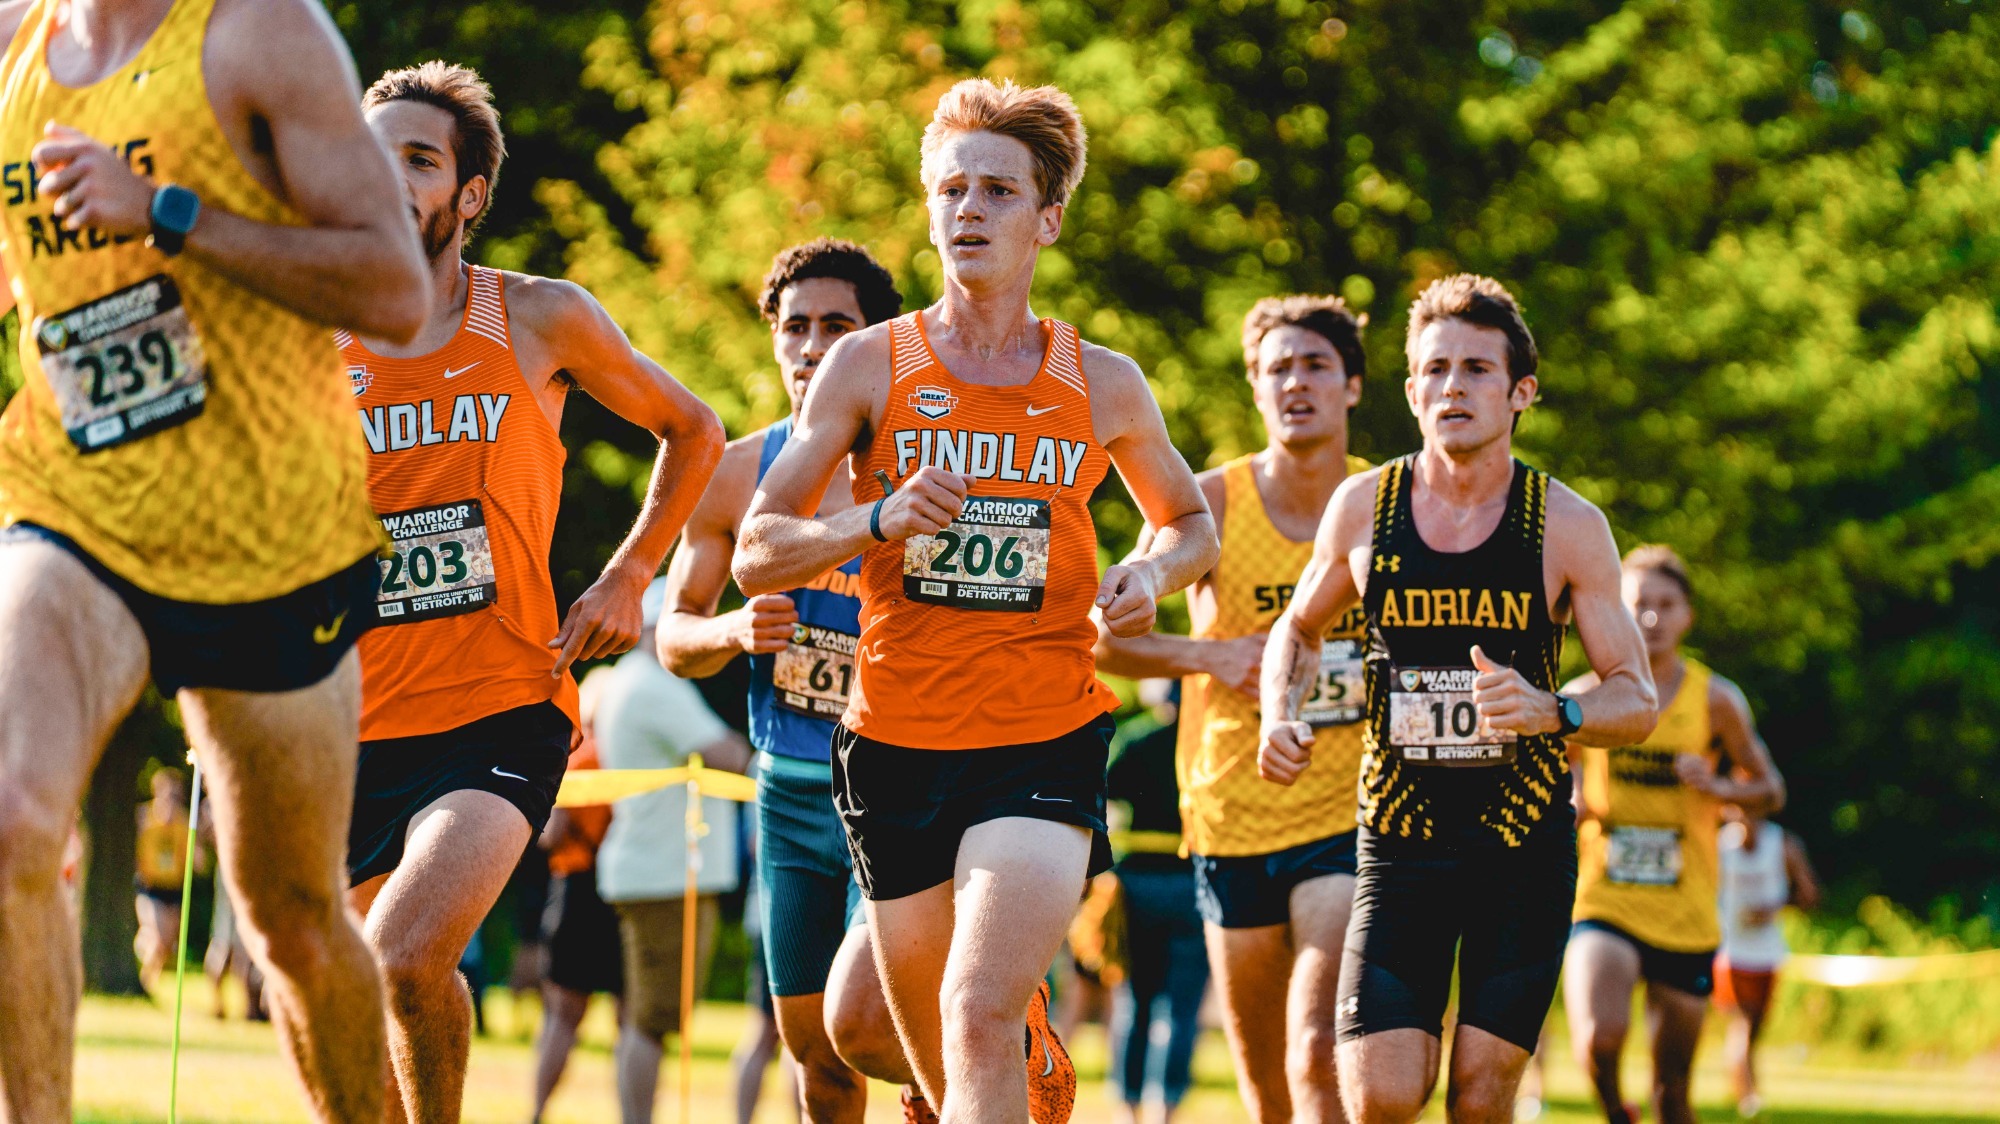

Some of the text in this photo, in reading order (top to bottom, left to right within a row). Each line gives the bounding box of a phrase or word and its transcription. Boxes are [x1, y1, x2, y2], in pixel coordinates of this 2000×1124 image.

[75, 330, 174, 408] 239
[909, 395, 958, 408] MIDWEST
[920, 393, 946, 401] GREAT
[358, 393, 511, 454] NDLAY
[894, 428, 1088, 487] FINDLAY
[382, 505, 469, 531] WARRIOR
[957, 512, 1031, 526] CHALLENGE
[392, 519, 464, 539] CHALLENGE
[930, 530, 1024, 579] 206
[379, 541, 467, 594] 203
[411, 587, 483, 603] WAYNE STATE UNIVERSITY
[957, 583, 980, 591] WAYNE
[957, 588, 1030, 602] DETROIT, MI
[413, 592, 484, 611] DETROIT, MI
[1380, 588, 1532, 630] ADRIAN
[810, 627, 858, 646] WARR
[809, 659, 851, 696] 61
[1427, 682, 1473, 692] CHALLE
[1430, 701, 1477, 737] 10
